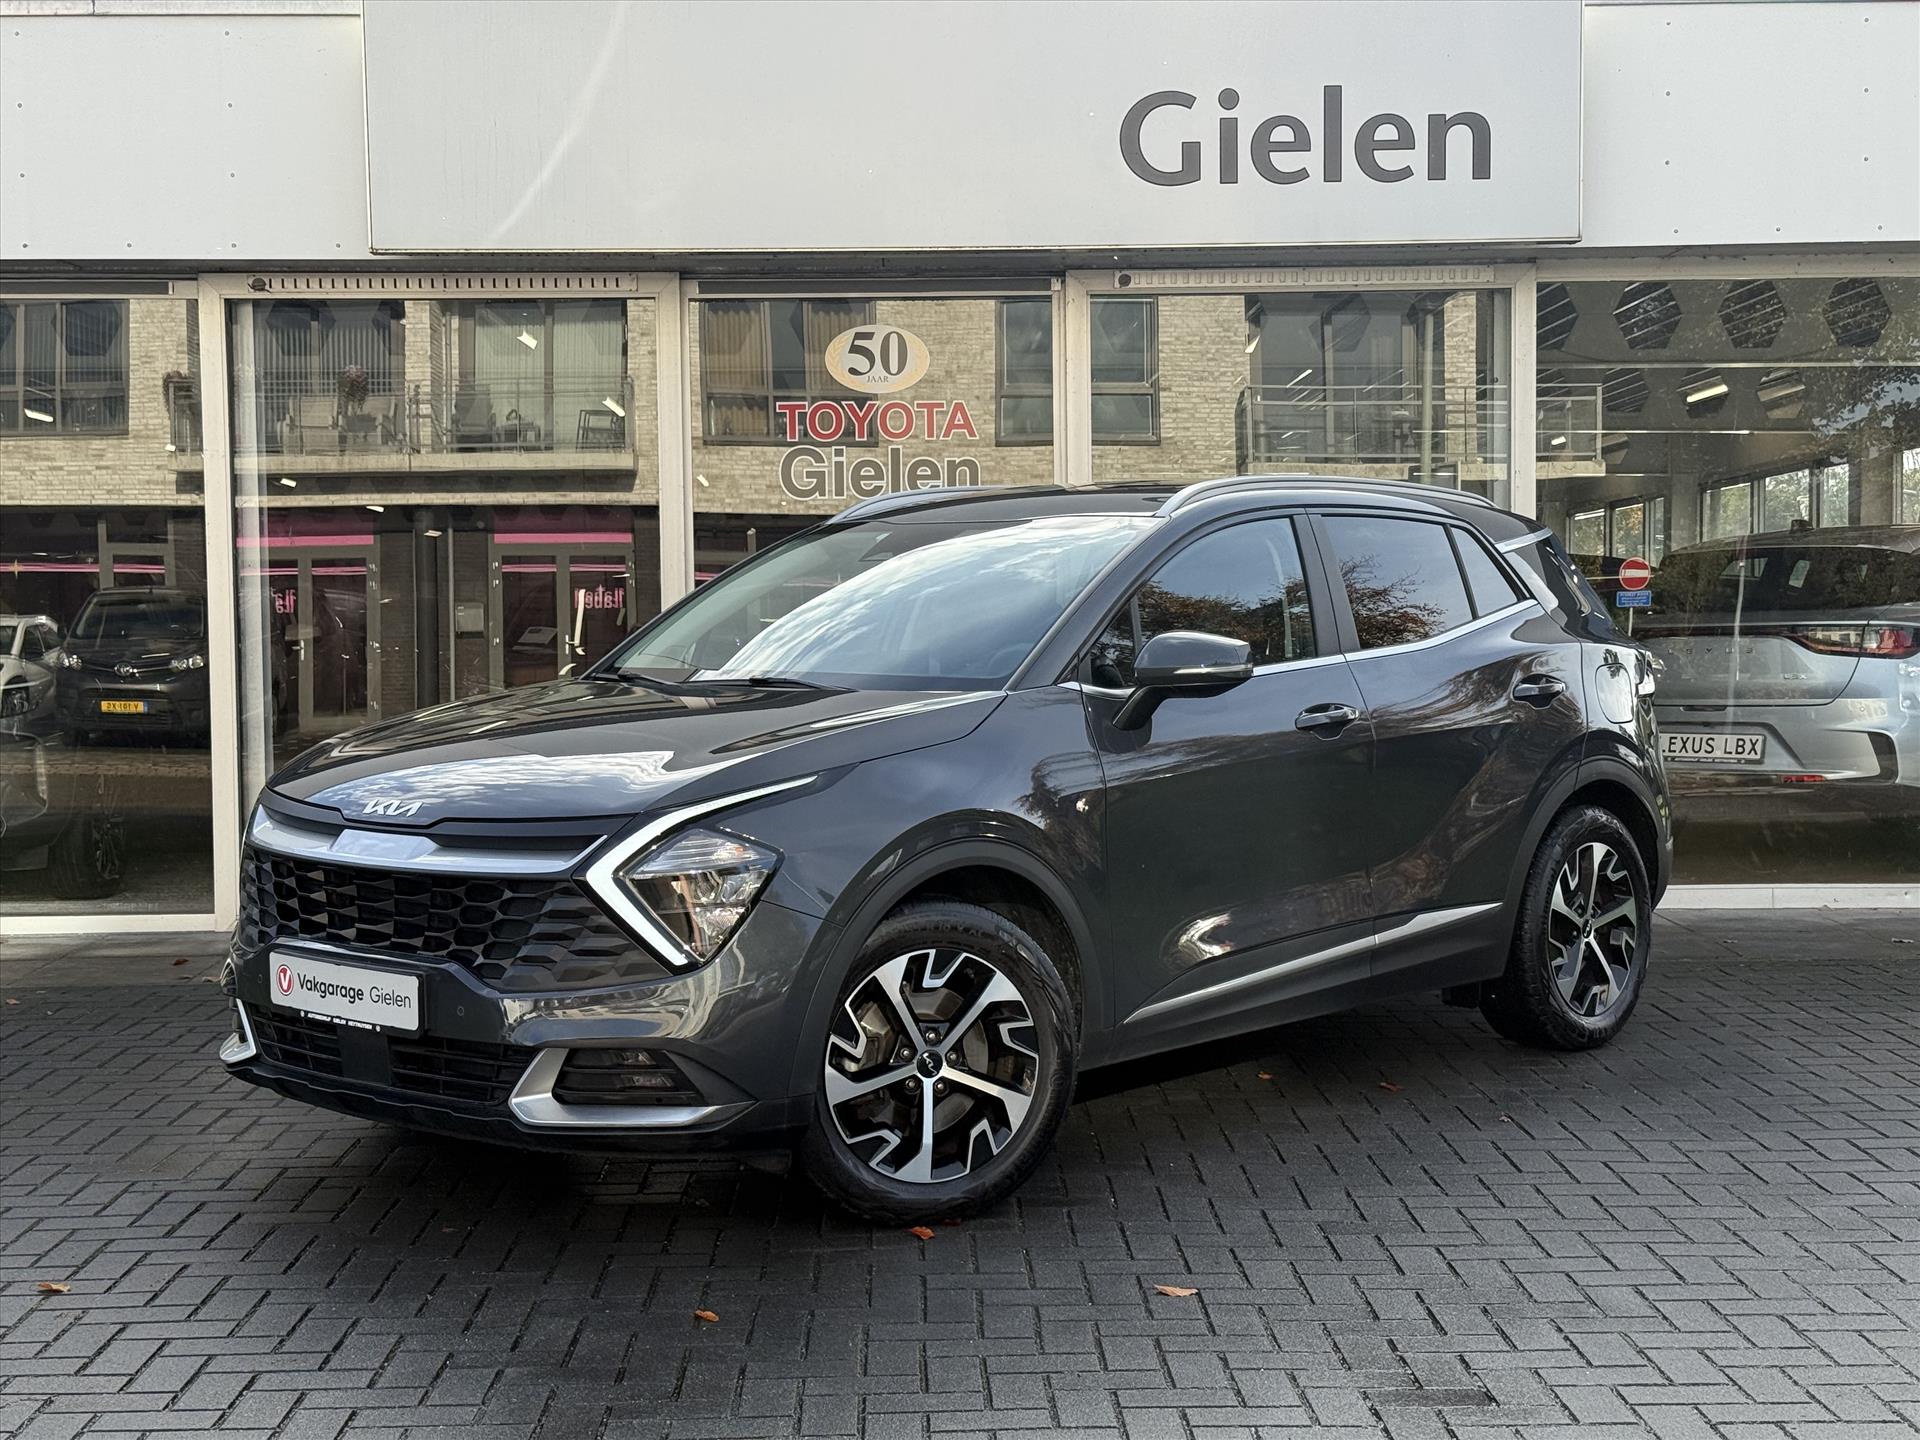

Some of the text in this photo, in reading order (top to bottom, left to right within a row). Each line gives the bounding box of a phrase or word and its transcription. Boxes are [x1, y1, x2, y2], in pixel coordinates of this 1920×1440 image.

[1119, 85, 1491, 187] Gielen
[847, 331, 908, 376] 50
[776, 400, 979, 441] TOYOTA
[780, 445, 981, 500] Gielen
[1723, 738, 1760, 756] LBX
[362, 799, 423, 817] KIA
[297, 972, 364, 1004] Vakgarage
[369, 986, 412, 1009] Gielen
